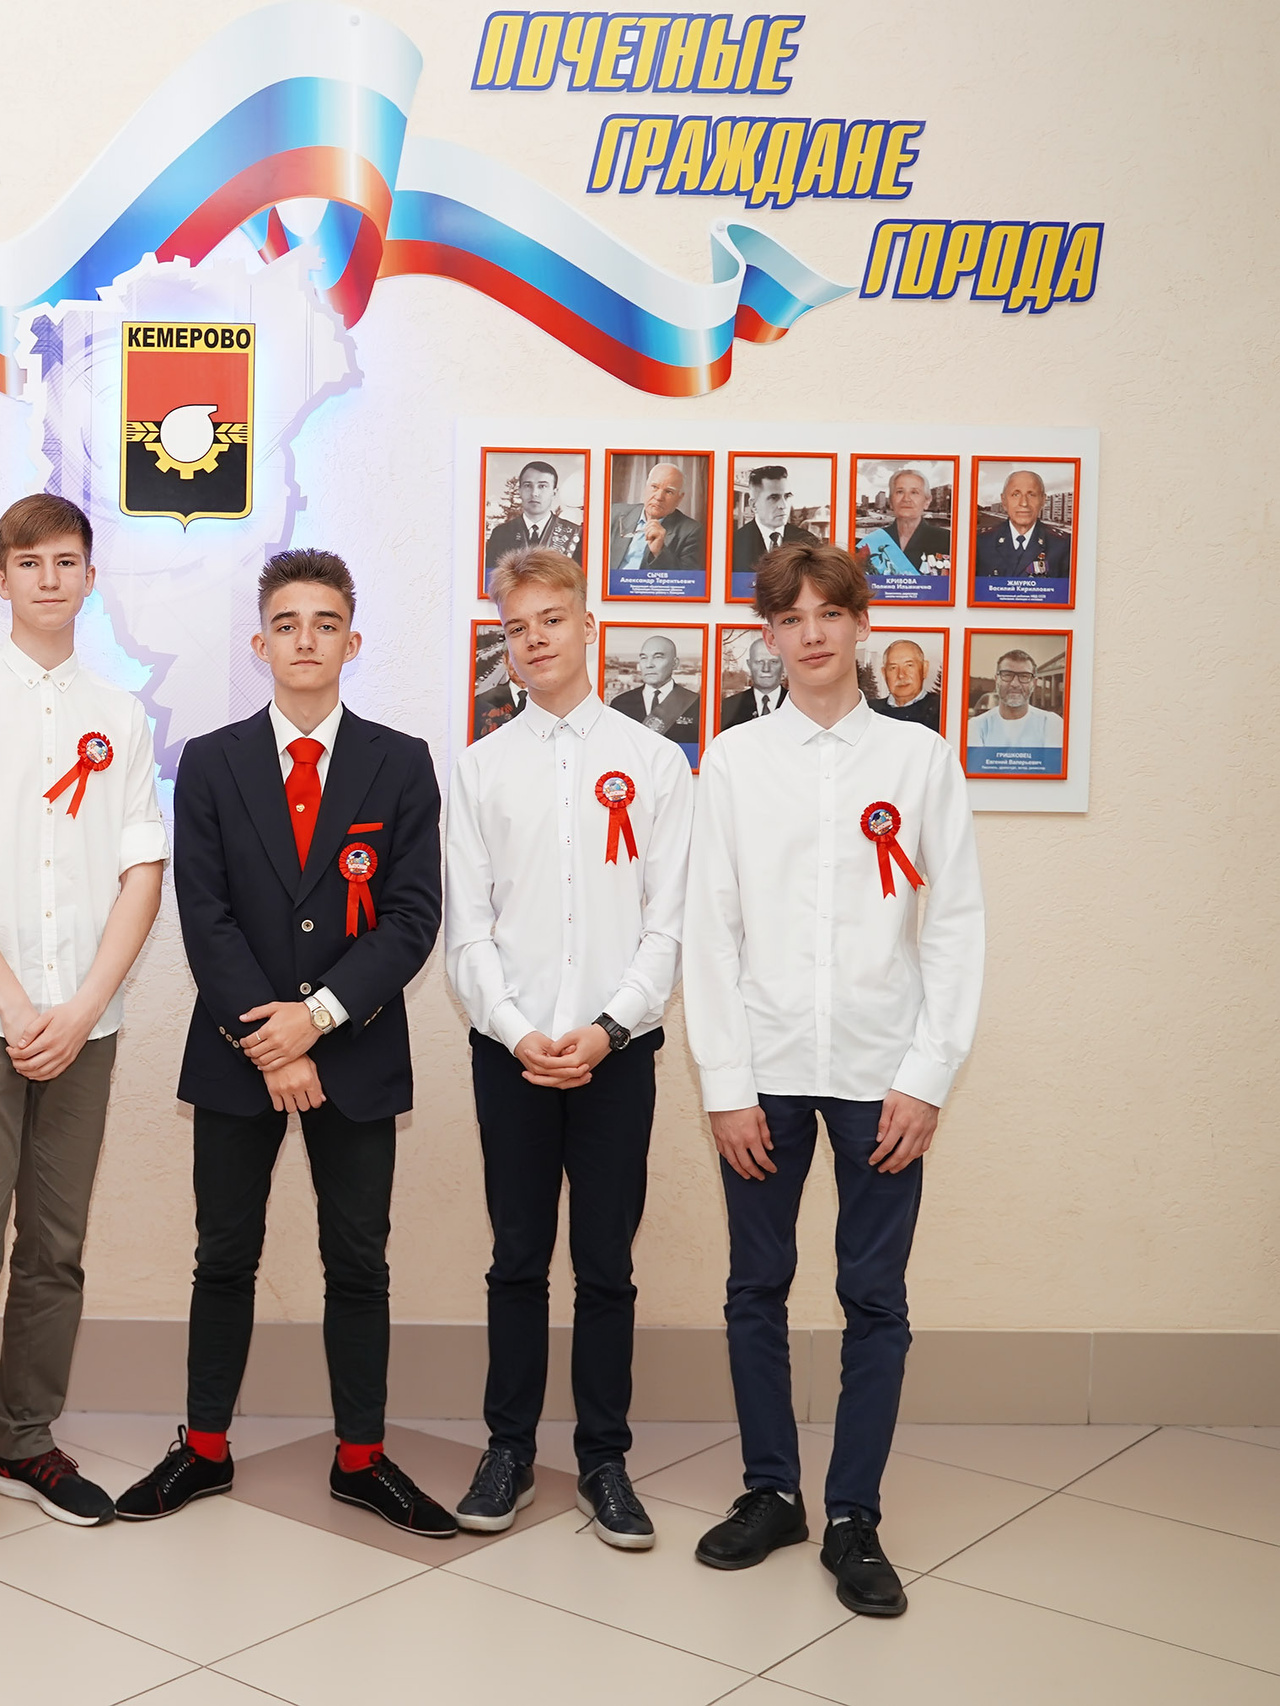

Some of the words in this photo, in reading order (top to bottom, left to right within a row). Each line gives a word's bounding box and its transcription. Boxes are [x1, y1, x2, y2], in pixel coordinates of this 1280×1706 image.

[470, 11, 806, 95] ПОЧЕТНЫЕ
[586, 113, 926, 210] ГРАЖДАНЕ
[858, 218, 1105, 314] ГОРОДА
[128, 327, 251, 349] КЕМЕРОВО
